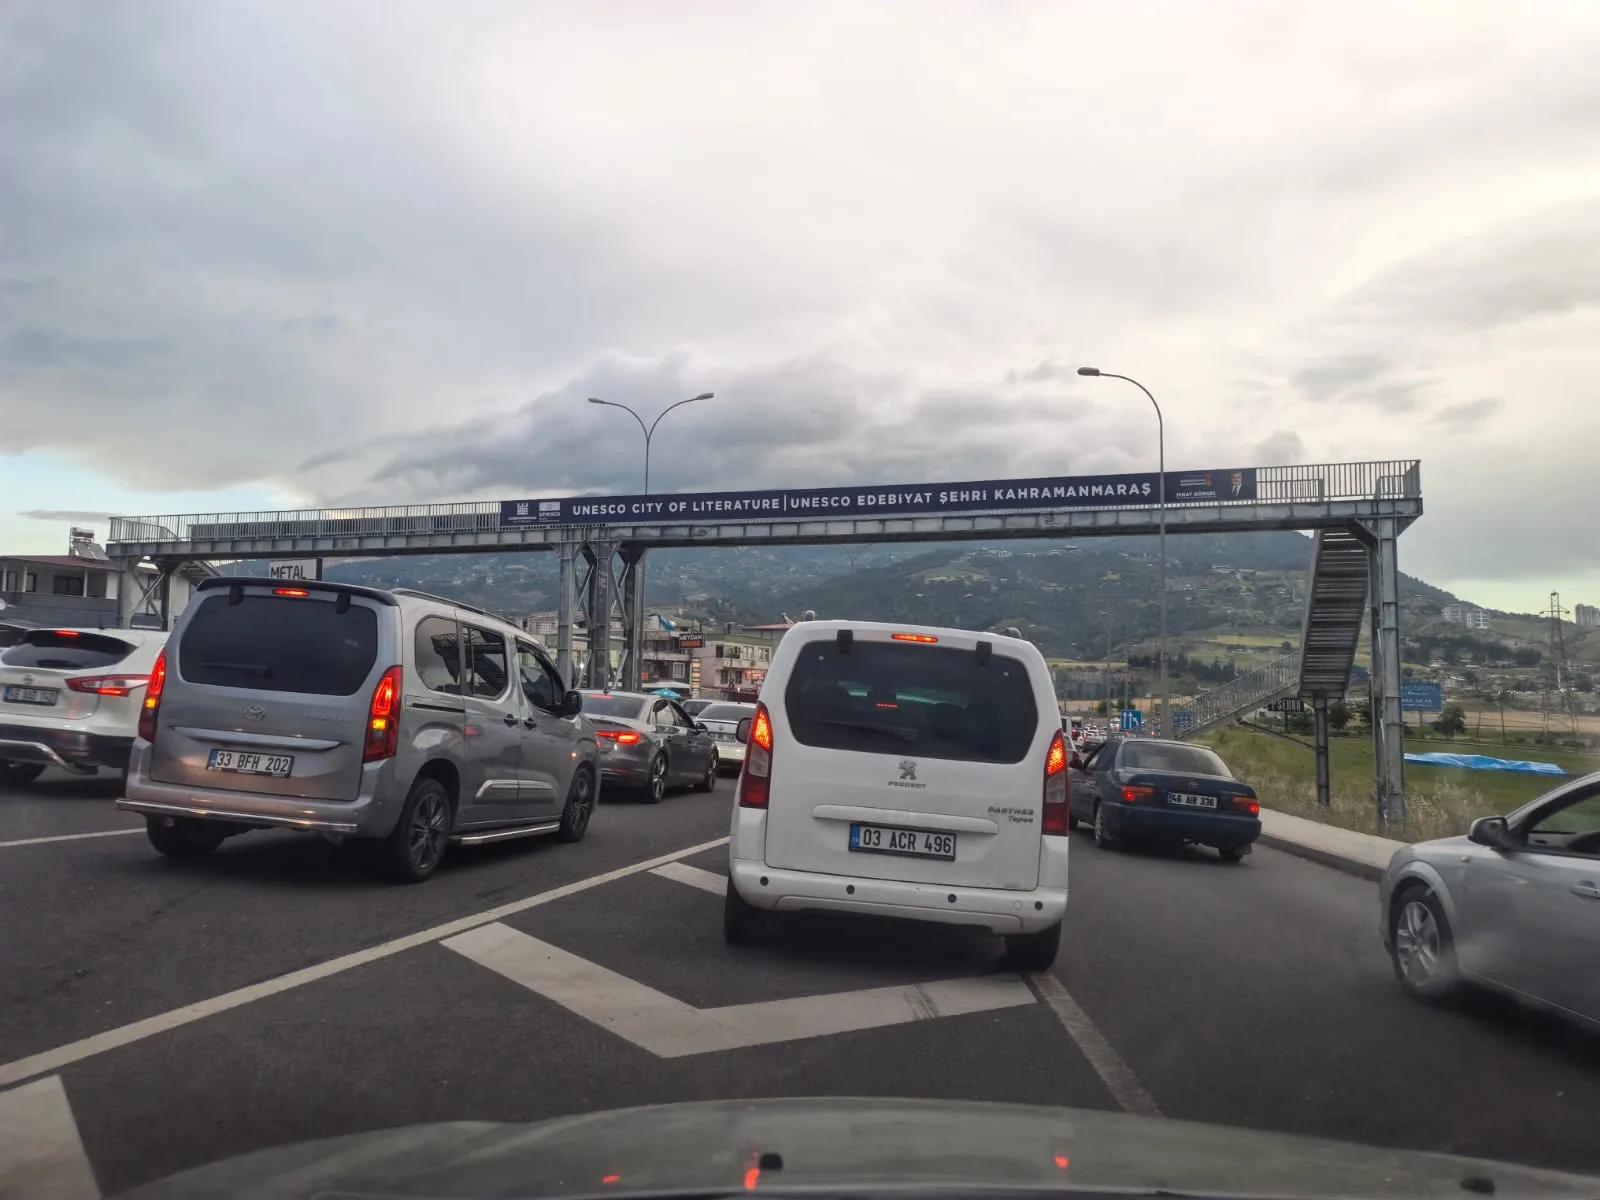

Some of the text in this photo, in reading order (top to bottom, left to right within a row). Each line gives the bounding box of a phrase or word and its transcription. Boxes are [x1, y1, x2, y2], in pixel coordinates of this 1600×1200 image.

[790, 496, 851, 509] UNESCO
[994, 482, 1151, 501] KAHRAMANMARAŞ
[572, 498, 780, 516] UNESCO CITY OF LITERATURE
[217, 752, 289, 773] 33 BFH 202
[987, 806, 1034, 817] PARTNER
[863, 829, 952, 854] 03 ACR 496
